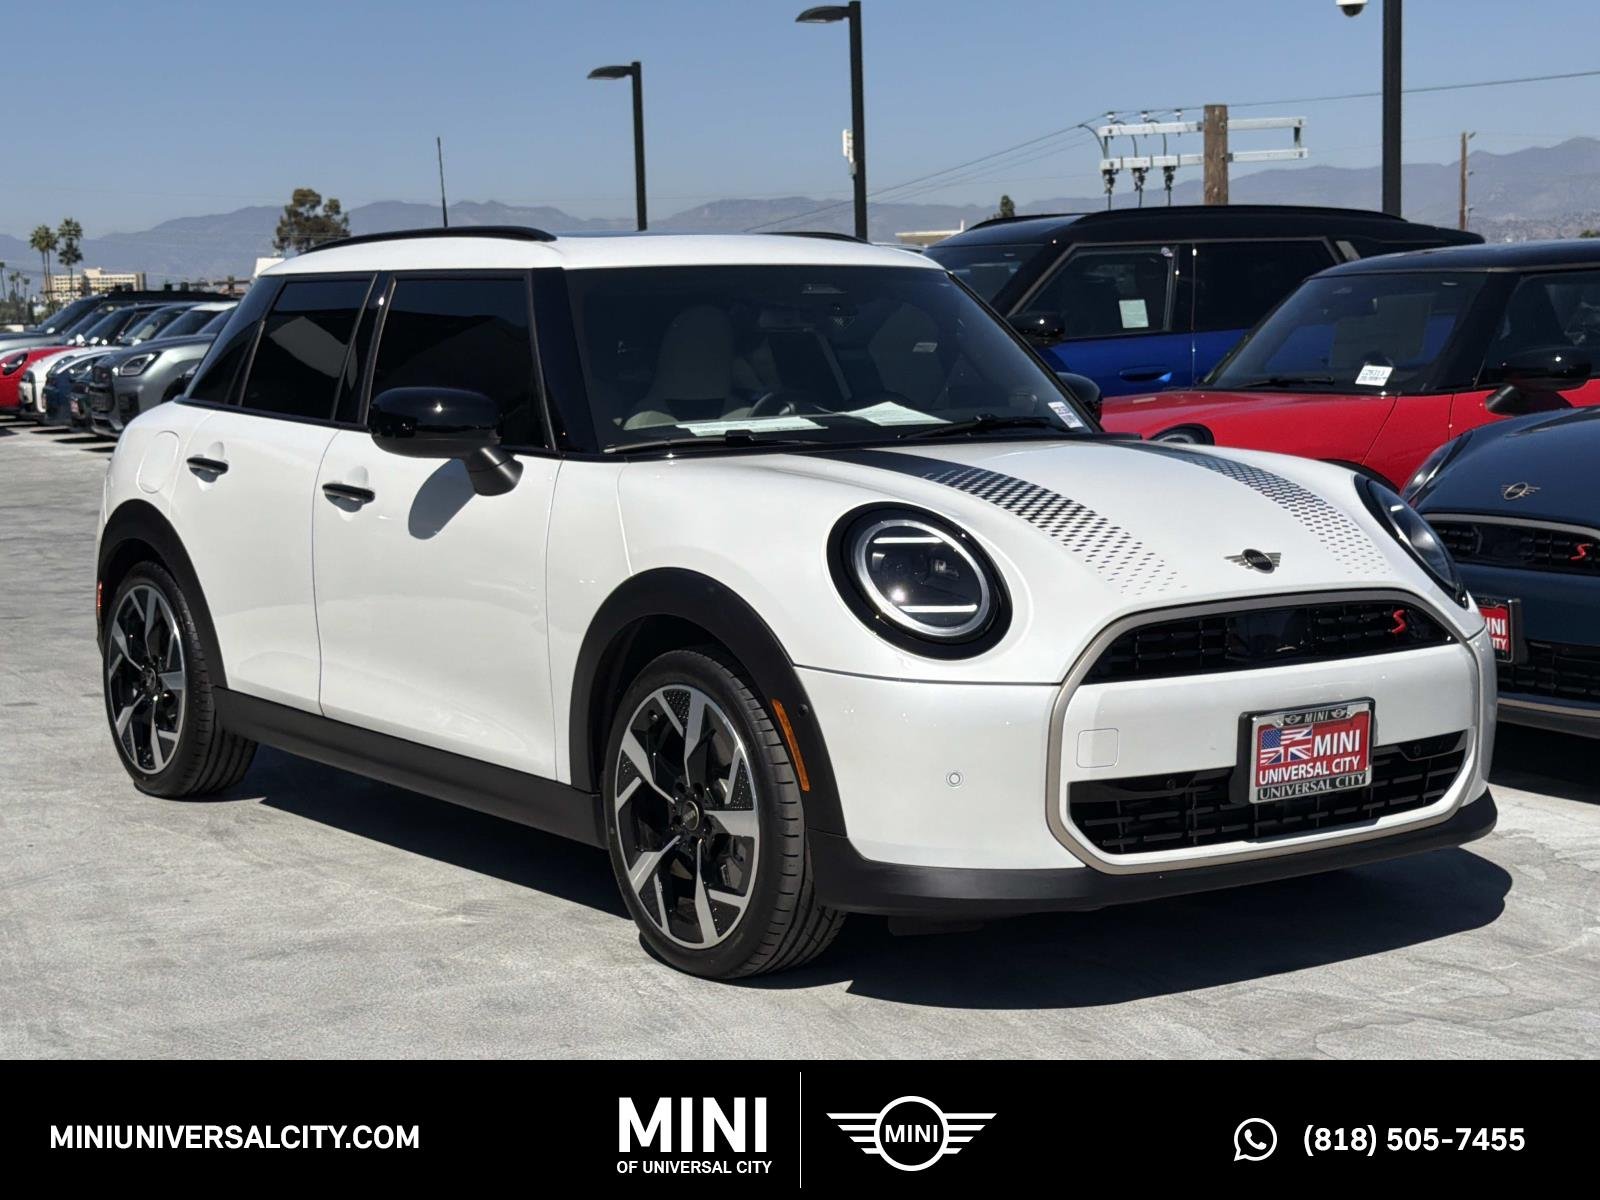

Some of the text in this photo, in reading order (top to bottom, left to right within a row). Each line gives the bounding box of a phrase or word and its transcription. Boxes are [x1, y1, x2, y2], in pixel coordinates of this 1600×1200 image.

[1391, 609, 1406, 633] S
[1486, 617, 1506, 635] INI
[1492, 637, 1507, 650] ITY
[1304, 711, 1329, 723] MINI
[1313, 729, 1360, 757] MINI
[1260, 755, 1360, 785] UNIVERSAL CITY
[1260, 773, 1366, 800] UNIVERSAL CITY
